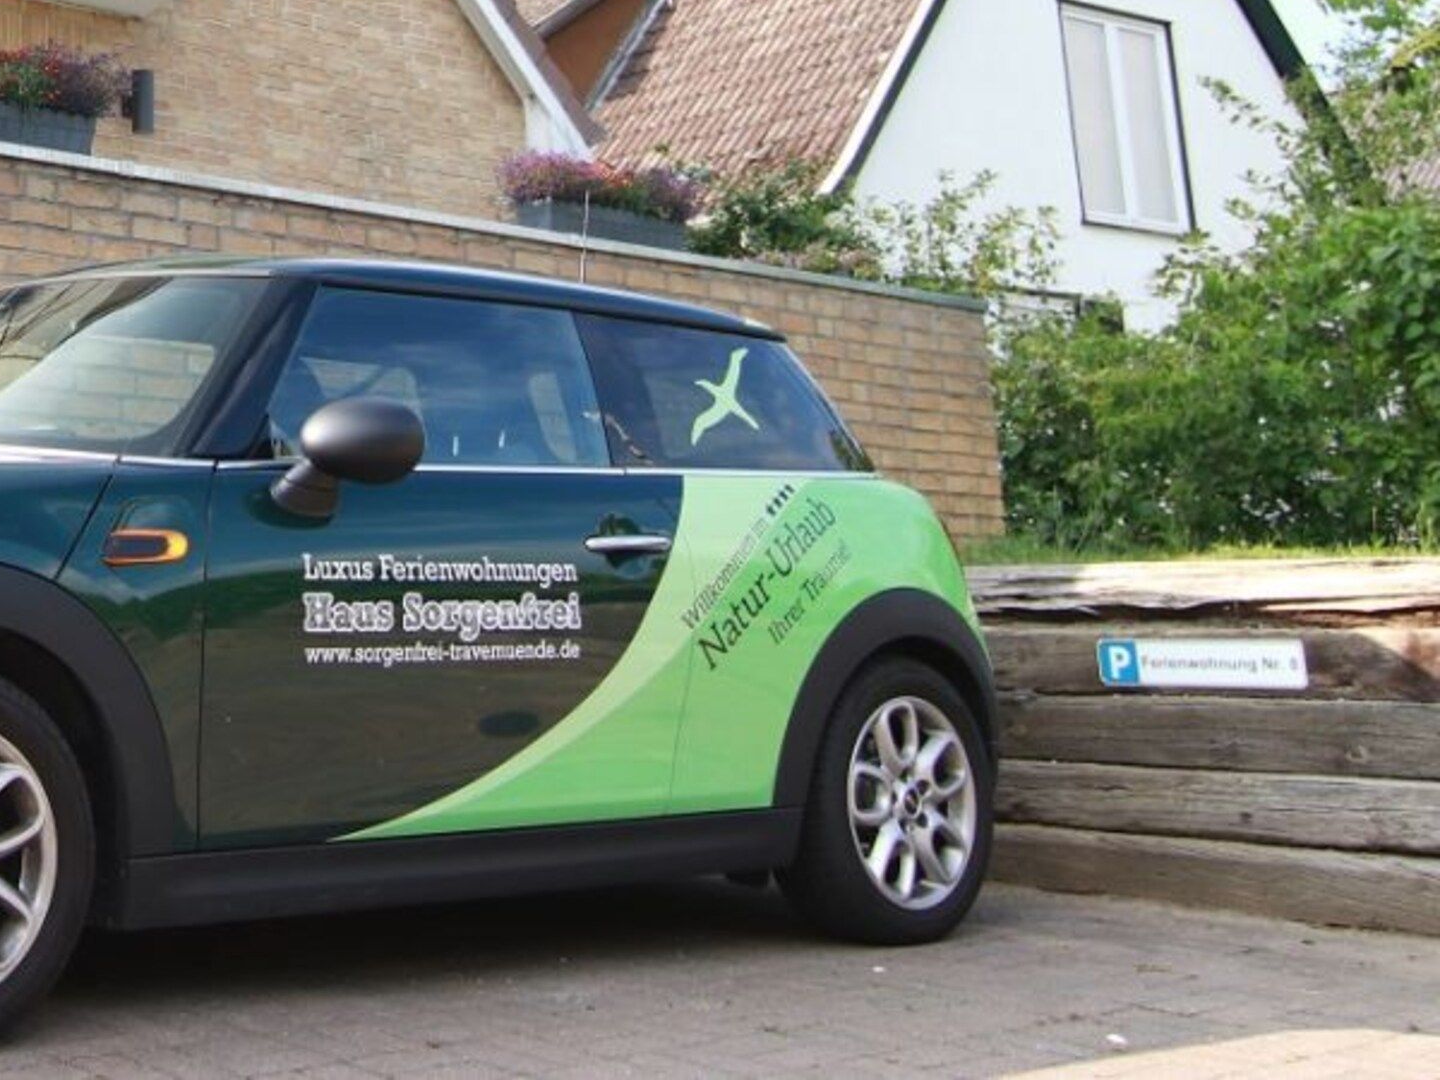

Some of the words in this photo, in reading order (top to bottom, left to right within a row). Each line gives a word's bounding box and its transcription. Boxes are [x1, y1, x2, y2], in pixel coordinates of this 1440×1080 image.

[301, 552, 375, 582] Luxus
[378, 553, 579, 589] Ferienwohnungen
[697, 496, 837, 671] Natur-Urlaub
[302, 591, 395, 632] Haus
[401, 590, 582, 642] Sorgenfrei
[303, 638, 582, 668] www.sorgenfrei-travemuende.de
[1108, 644, 1133, 680] P
[1140, 655, 1258, 675] Ferienwohnung
